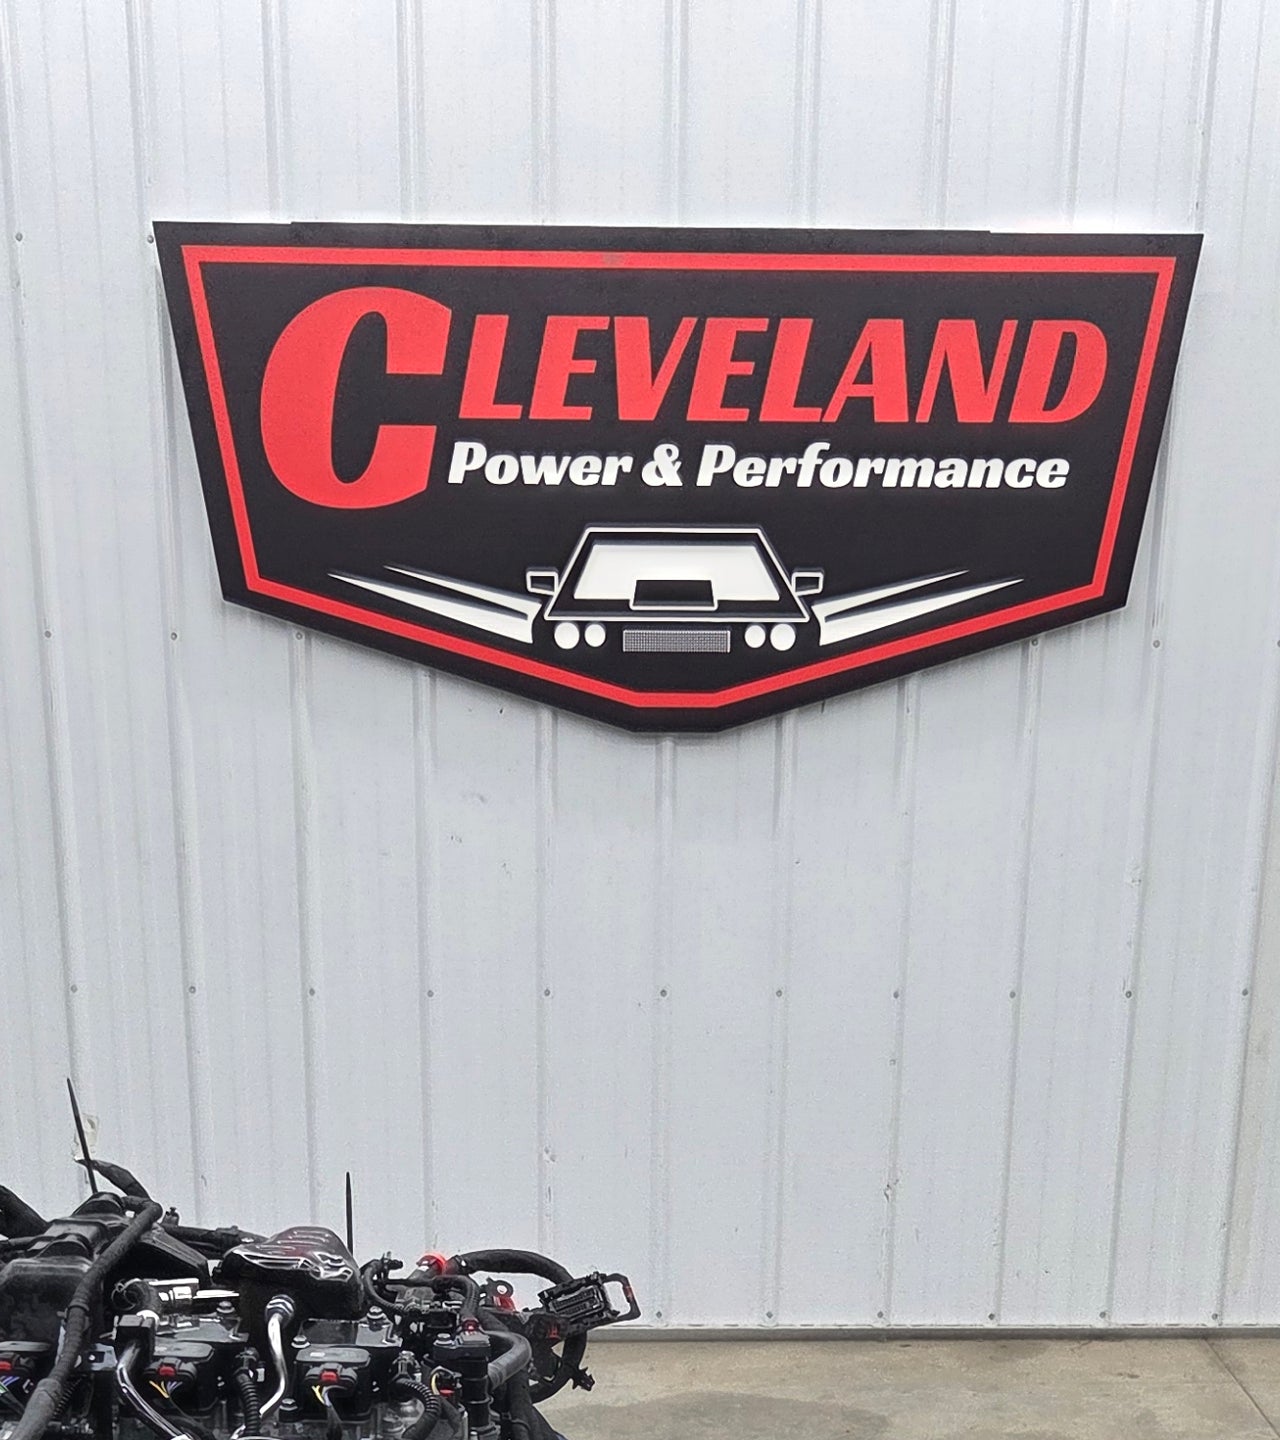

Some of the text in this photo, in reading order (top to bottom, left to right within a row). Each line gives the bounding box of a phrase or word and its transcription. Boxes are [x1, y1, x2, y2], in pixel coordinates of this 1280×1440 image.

[261, 286, 1108, 510] CLEVELAND
[447, 441, 1070, 489] Power & Performance
